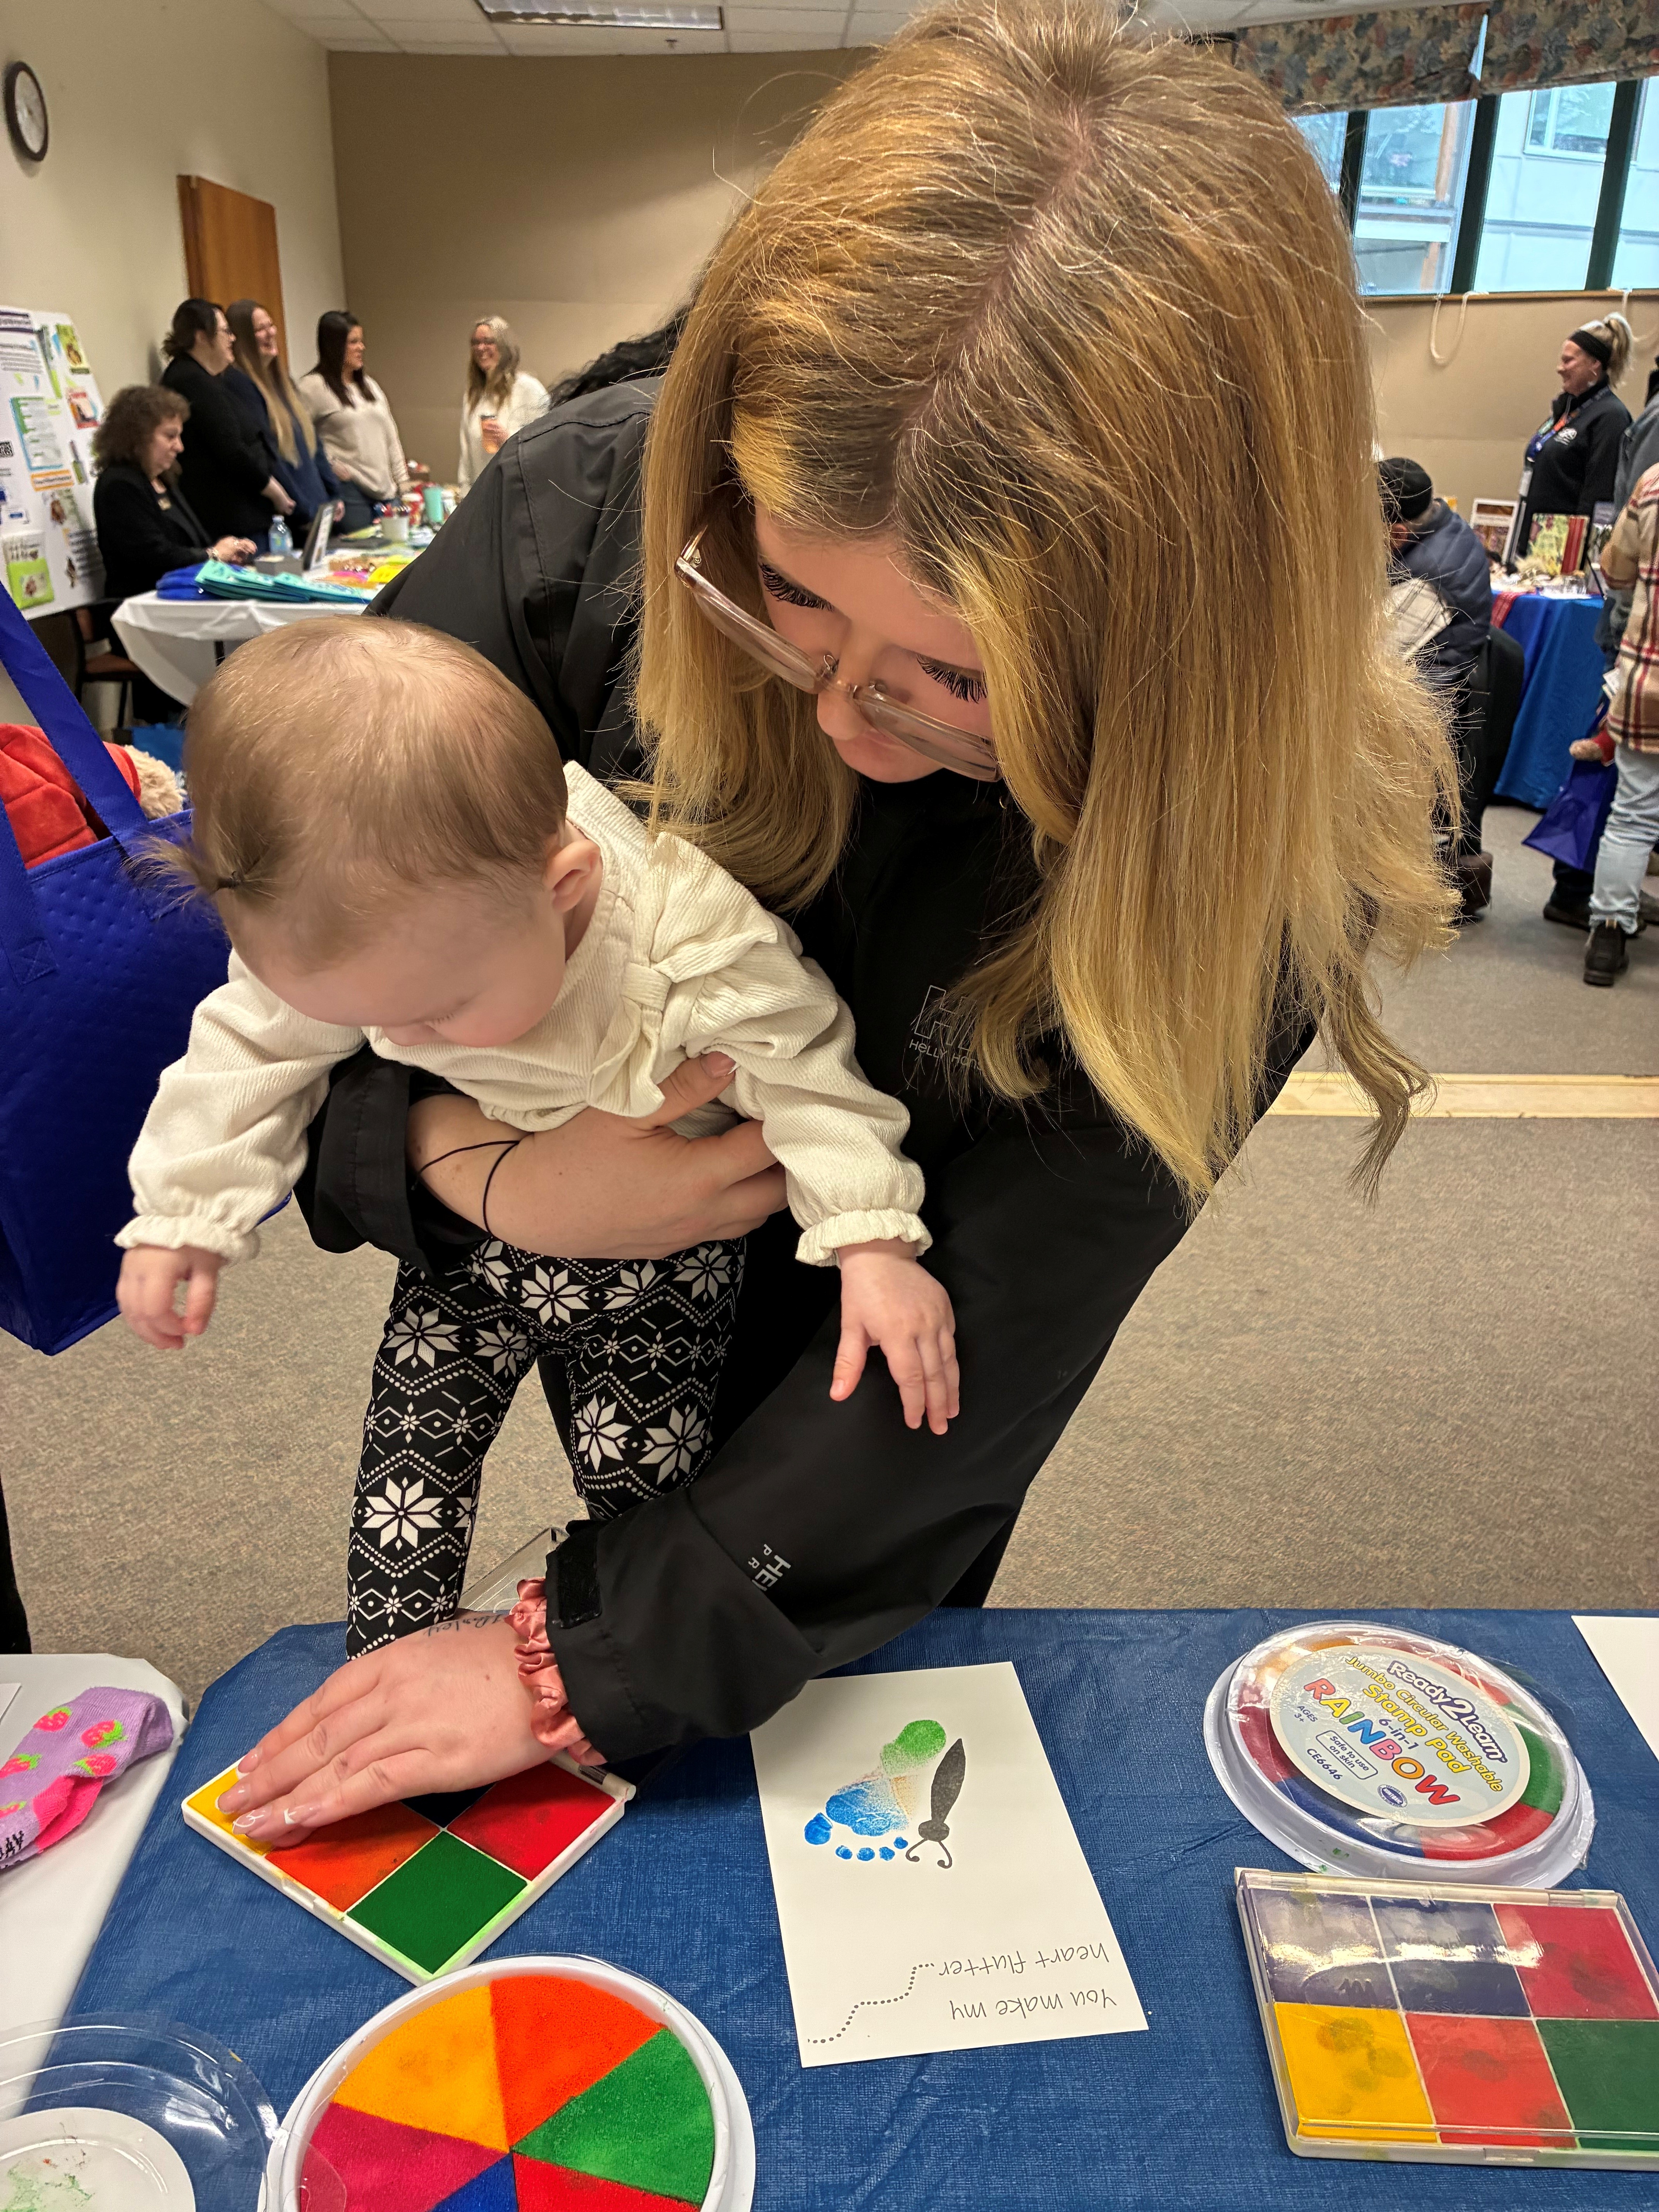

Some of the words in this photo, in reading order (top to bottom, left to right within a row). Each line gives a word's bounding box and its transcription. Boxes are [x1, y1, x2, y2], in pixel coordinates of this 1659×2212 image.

[1294, 1713, 1304, 1722] 3+
[1297, 1706, 1317, 1722] AGES
[1346, 1656, 1395, 1690] Jumbo
[1396, 1690, 1449, 1731] Circular
[1446, 1731, 1503, 1791] Washable
[1387, 1661, 1507, 1763] Ready2Learn
[1304, 1678, 1461, 1805] RAINBOW
[1363, 1684, 1427, 1737] Stamp
[1425, 1738, 1472, 1773] Pad
[1379, 1719, 1419, 1750] 6-in-1
[1307, 1748, 1343, 1780] CE6646
[1329, 1746, 1340, 1755] on
[1340, 1755, 1355, 1768] skin
[1330, 1736, 1347, 1751] Safe
[1355, 1759, 1369, 1771] use
[1035, 1942, 1109, 1968] heart
[950, 2000, 987, 2020] my
[996, 1994, 1063, 2019] make
[1070, 1989, 1117, 2009] You
